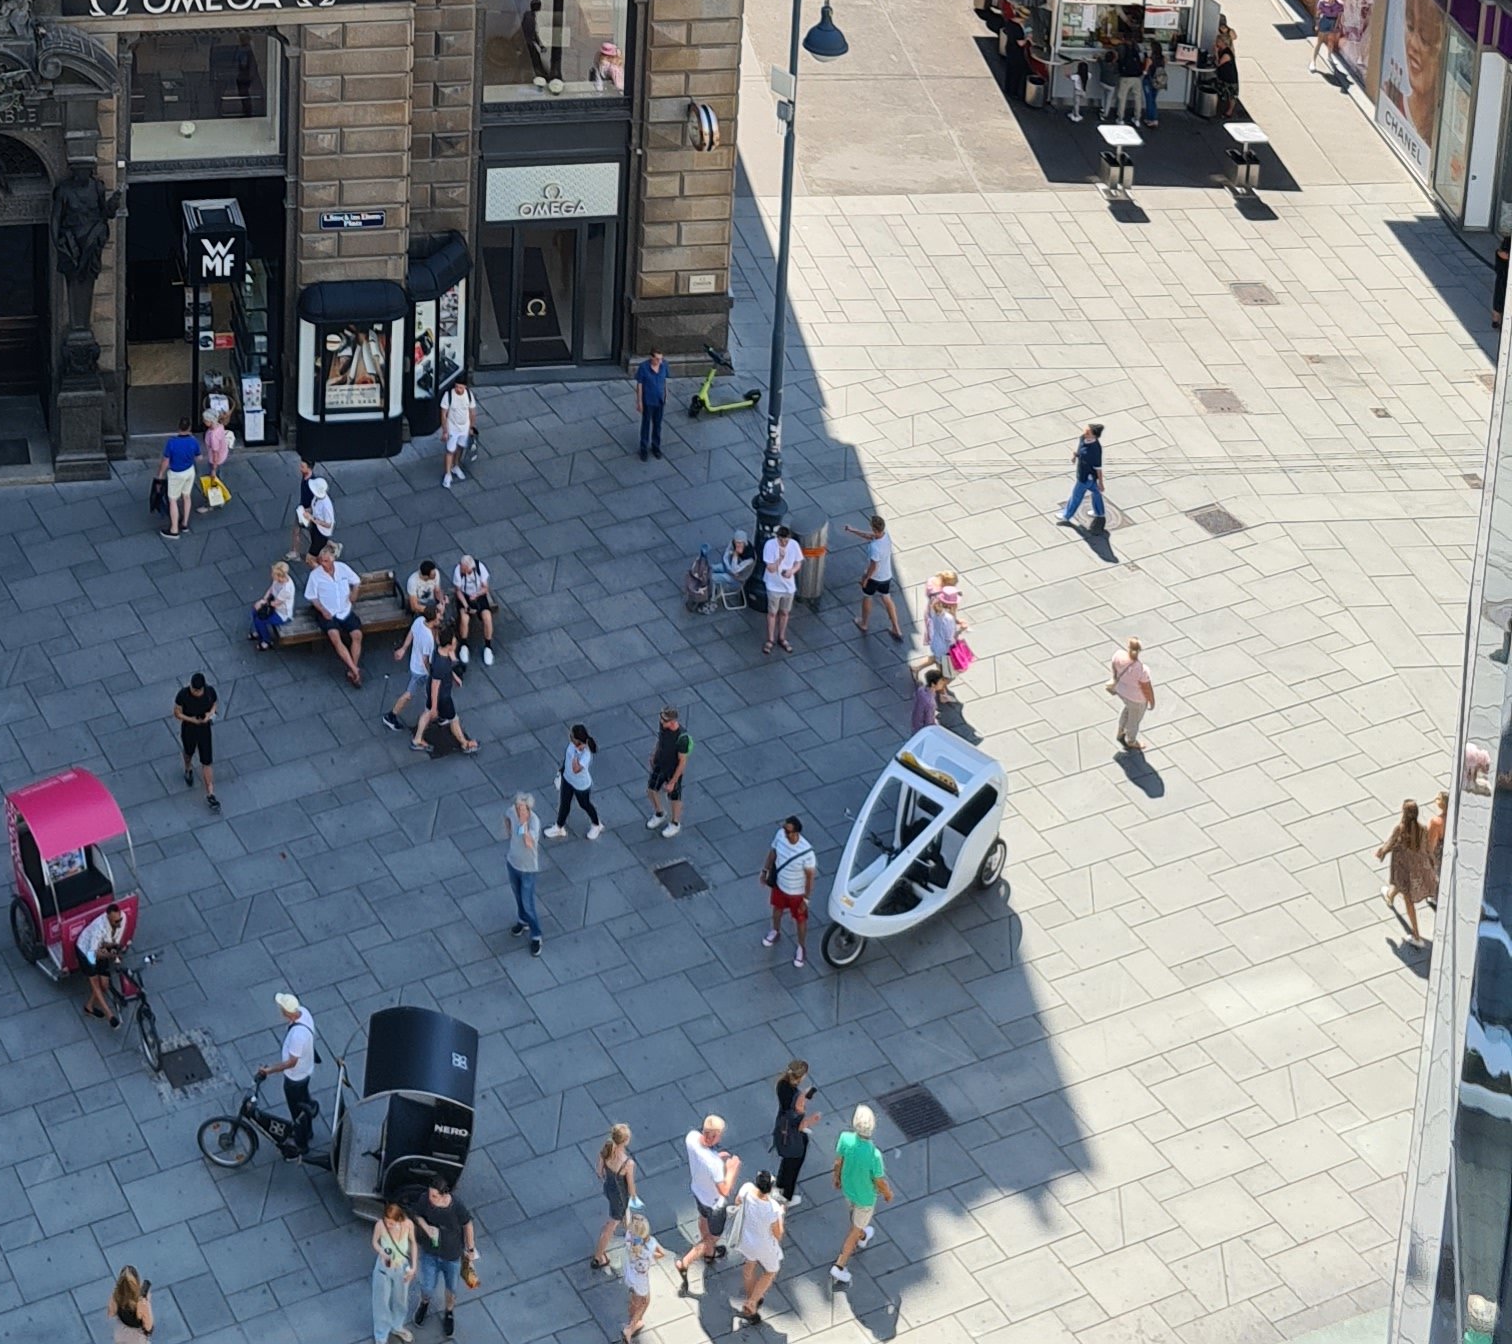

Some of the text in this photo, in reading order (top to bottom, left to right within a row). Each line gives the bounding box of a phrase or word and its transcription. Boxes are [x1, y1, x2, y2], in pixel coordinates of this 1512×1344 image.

[1385, 110, 1422, 166] CHANEL
[519, 200, 588, 217] OMEGA
[434, 1123, 468, 1137] NERO
